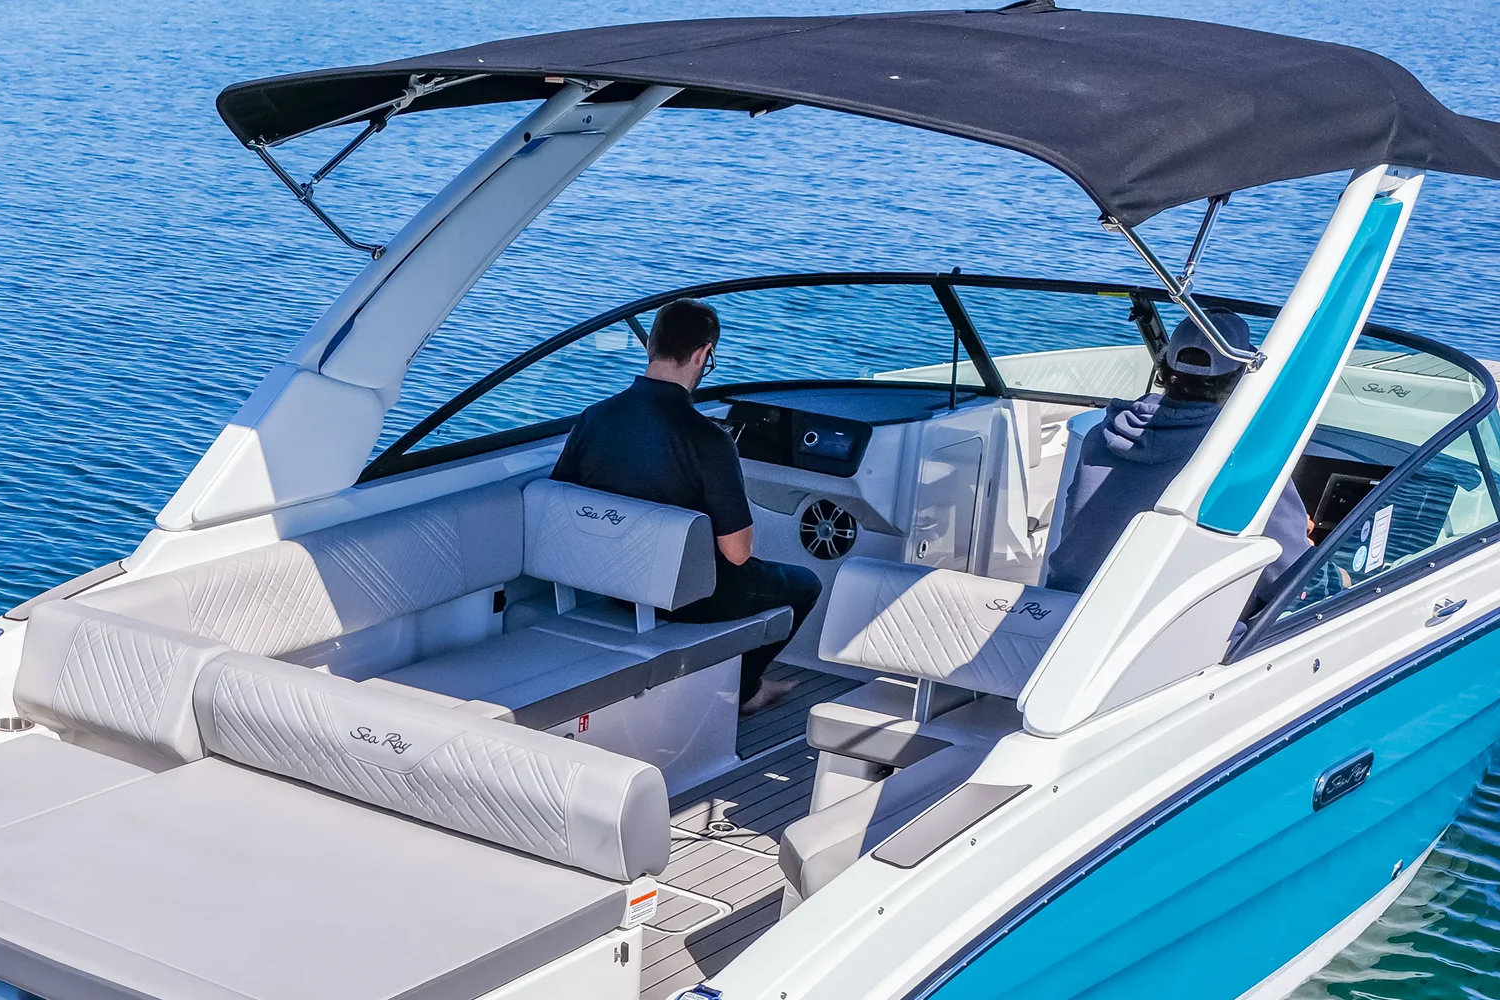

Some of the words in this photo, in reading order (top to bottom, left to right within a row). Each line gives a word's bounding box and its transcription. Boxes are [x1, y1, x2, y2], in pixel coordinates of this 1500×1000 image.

[1362, 383, 1386, 393] Sea
[1387, 385, 1411, 398] Ray
[576, 506, 600, 519] Sea
[601, 509, 626, 525] Ray
[985, 599, 1017, 613] Sea
[1019, 602, 1052, 620] Ray
[349, 726, 380, 744] Sea
[381, 732, 412, 754] Ray
